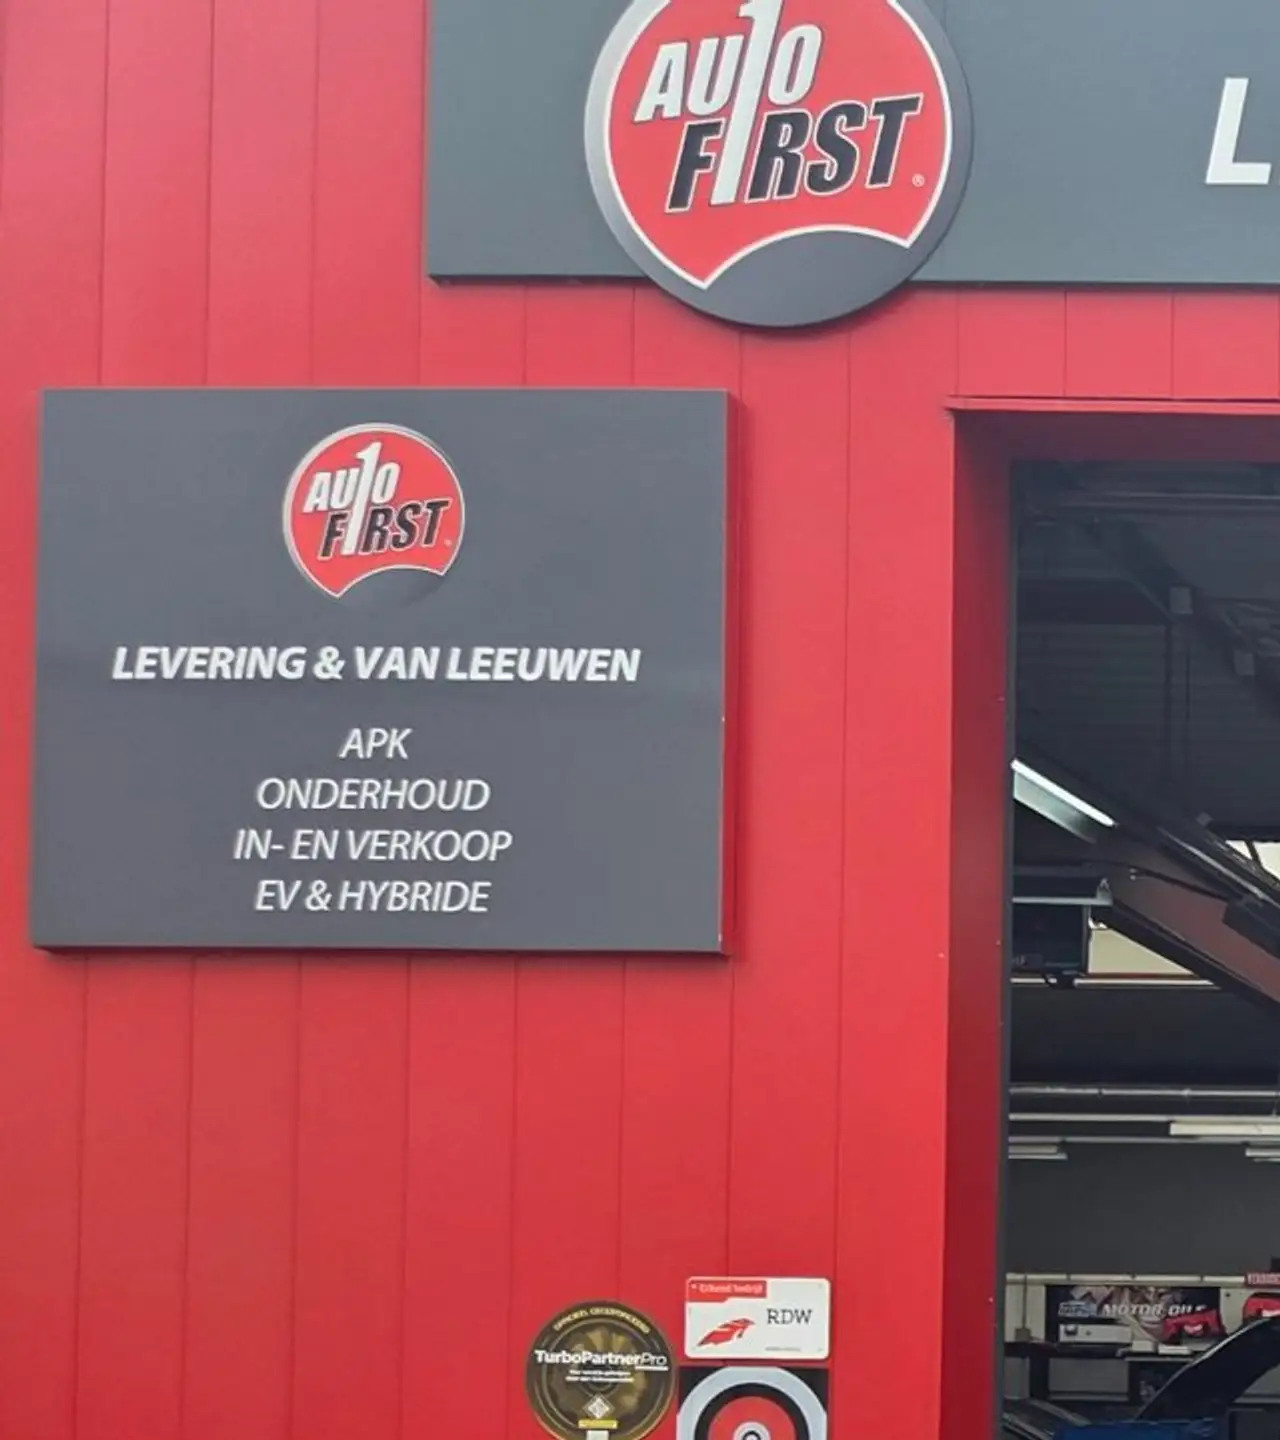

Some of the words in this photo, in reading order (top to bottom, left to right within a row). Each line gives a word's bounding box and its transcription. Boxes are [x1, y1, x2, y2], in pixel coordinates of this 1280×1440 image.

[112, 646, 307, 680] LEVERING
[313, 645, 345, 680] &
[355, 646, 441, 680] VAN
[446, 646, 642, 682] LEEUWEN
[338, 727, 413, 760] APK
[256, 777, 491, 811] ONDERHOUD
[233, 828, 285, 860] IN-
[290, 828, 340, 860] EN
[346, 829, 513, 862] VERKOOP
[255, 879, 303, 912] EV
[304, 879, 333, 912] &
[337, 880, 492, 913] HYBRIDE
[766, 1308, 812, 1326] RDW
[1101, 1303, 1163, 1317] MOTOR
